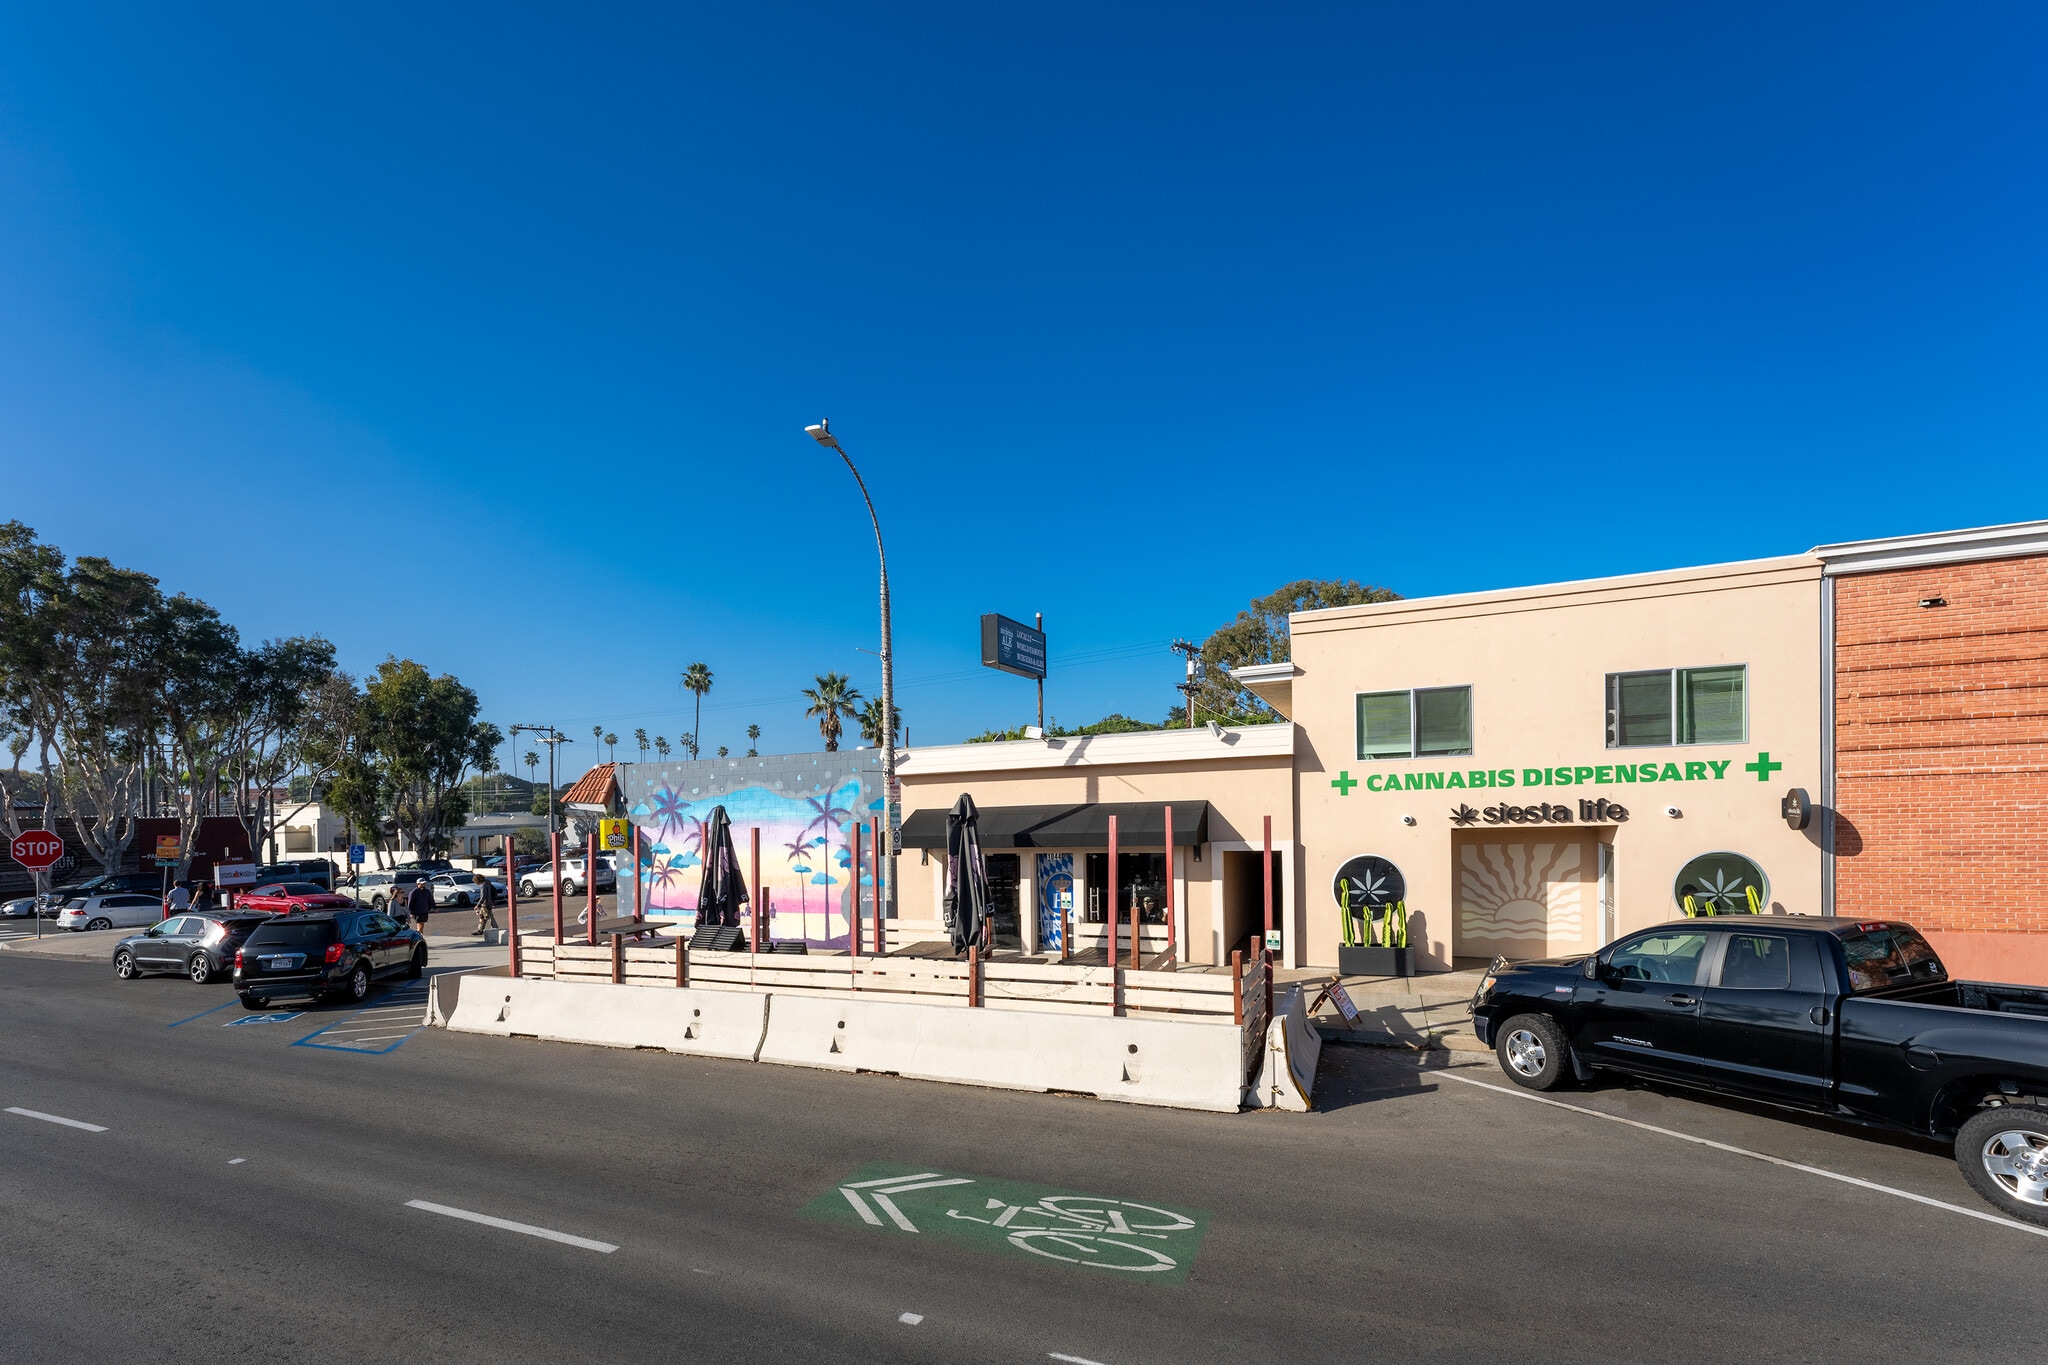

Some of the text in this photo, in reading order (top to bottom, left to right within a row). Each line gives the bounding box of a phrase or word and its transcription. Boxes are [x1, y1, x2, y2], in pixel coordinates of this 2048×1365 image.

[1366, 760, 1732, 792] CANNABIS DISPENSARY
[1483, 798, 1628, 824] siesta life
[607, 833, 626, 844] Philz
[15, 841, 60, 856] STOP
[1612, 1035, 1654, 1048] TUNDRA
